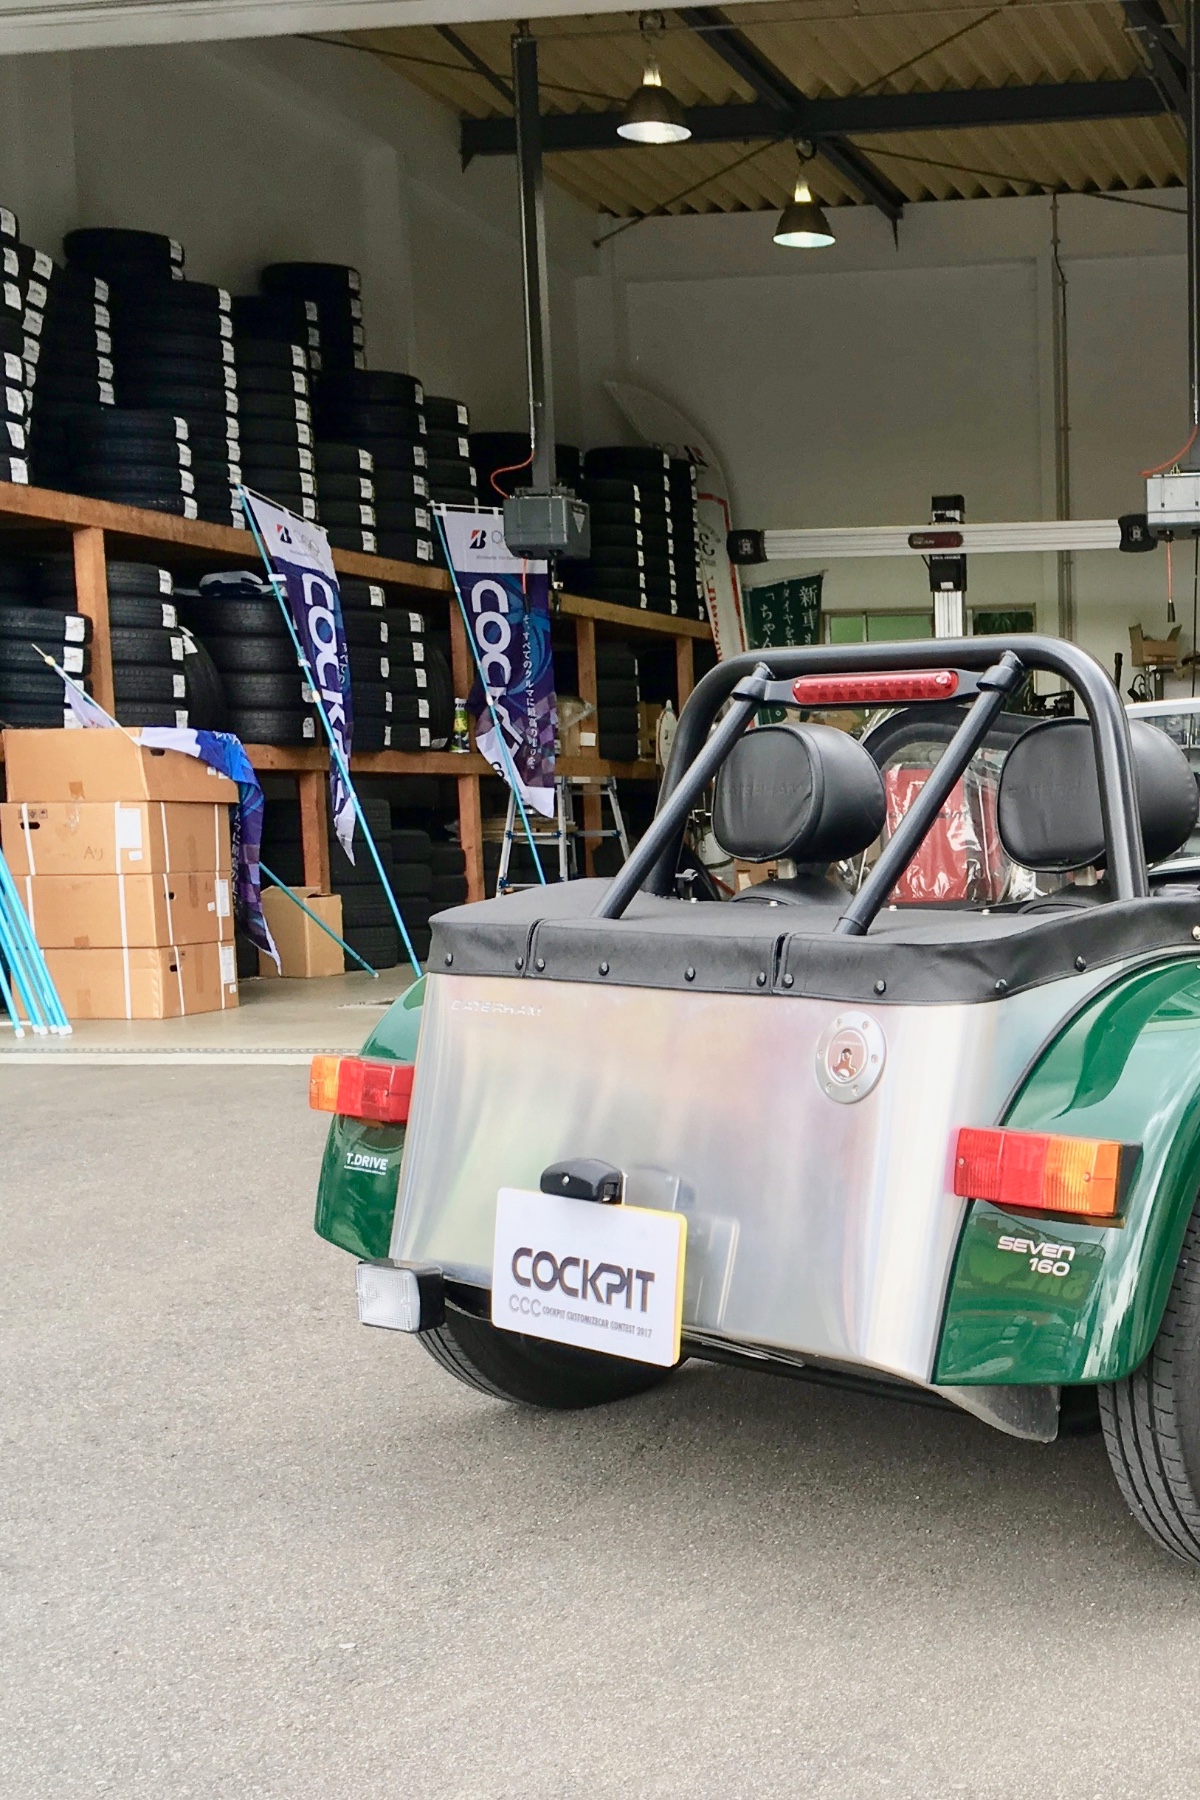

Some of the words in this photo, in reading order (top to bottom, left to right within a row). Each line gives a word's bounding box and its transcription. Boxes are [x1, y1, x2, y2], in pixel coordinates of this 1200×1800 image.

[451, 1000, 542, 1016] CATERHAM
[346, 1152, 388, 1170] T.DRIVE
[1029, 1257, 1071, 1276] 160
[512, 1247, 655, 1312] COCKPIT
[510, 1294, 541, 1317] CCC
[543, 1305, 566, 1318] COCKPIT
[611, 1321, 635, 1334] CONTEST
[636, 1326, 653, 1339] 2017
